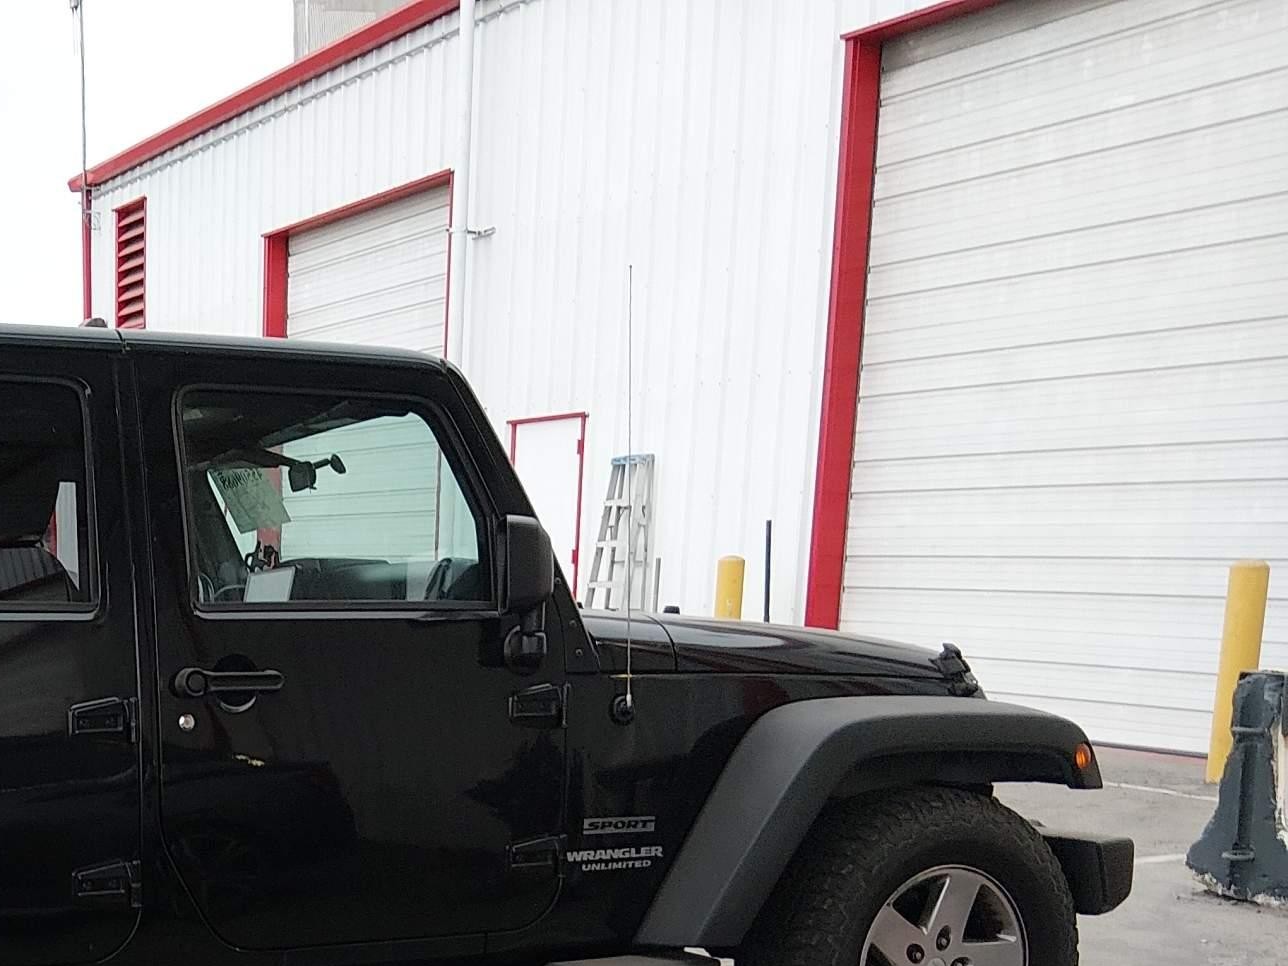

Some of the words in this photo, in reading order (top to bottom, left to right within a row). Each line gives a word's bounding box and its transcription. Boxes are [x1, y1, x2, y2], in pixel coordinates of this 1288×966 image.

[587, 819, 656, 831] SPORT
[566, 846, 664, 862] WRANGLER
[581, 860, 651, 872] UNLIMITED
